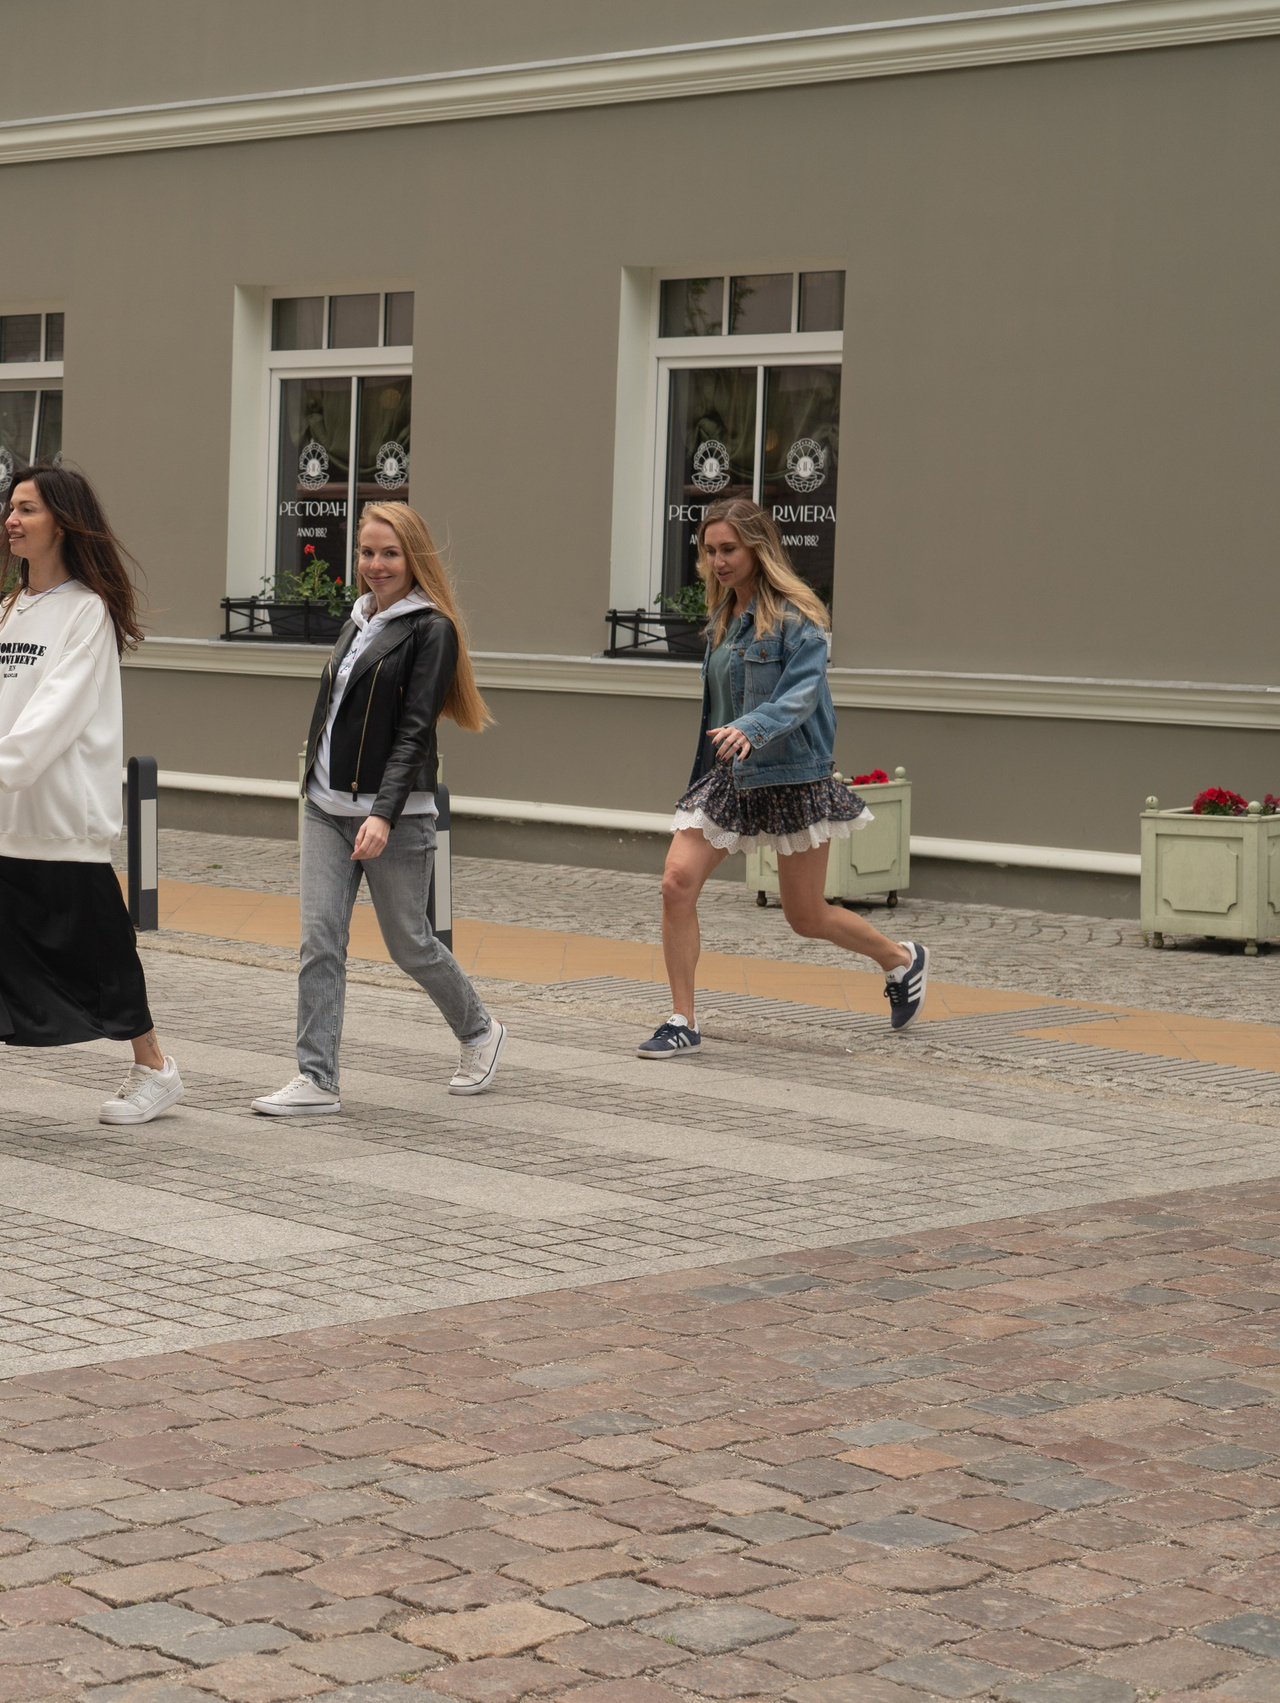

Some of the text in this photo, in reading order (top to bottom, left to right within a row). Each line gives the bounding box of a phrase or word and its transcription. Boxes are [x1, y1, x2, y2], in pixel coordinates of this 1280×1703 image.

[279, 501, 347, 517] РЕСТОРАН
[669, 504, 710, 522] РЕСТ
[772, 504, 836, 522] RIVIERA
[297, 527, 328, 538] ANNO 1882
[781, 534, 820, 547] ANNO 1882
